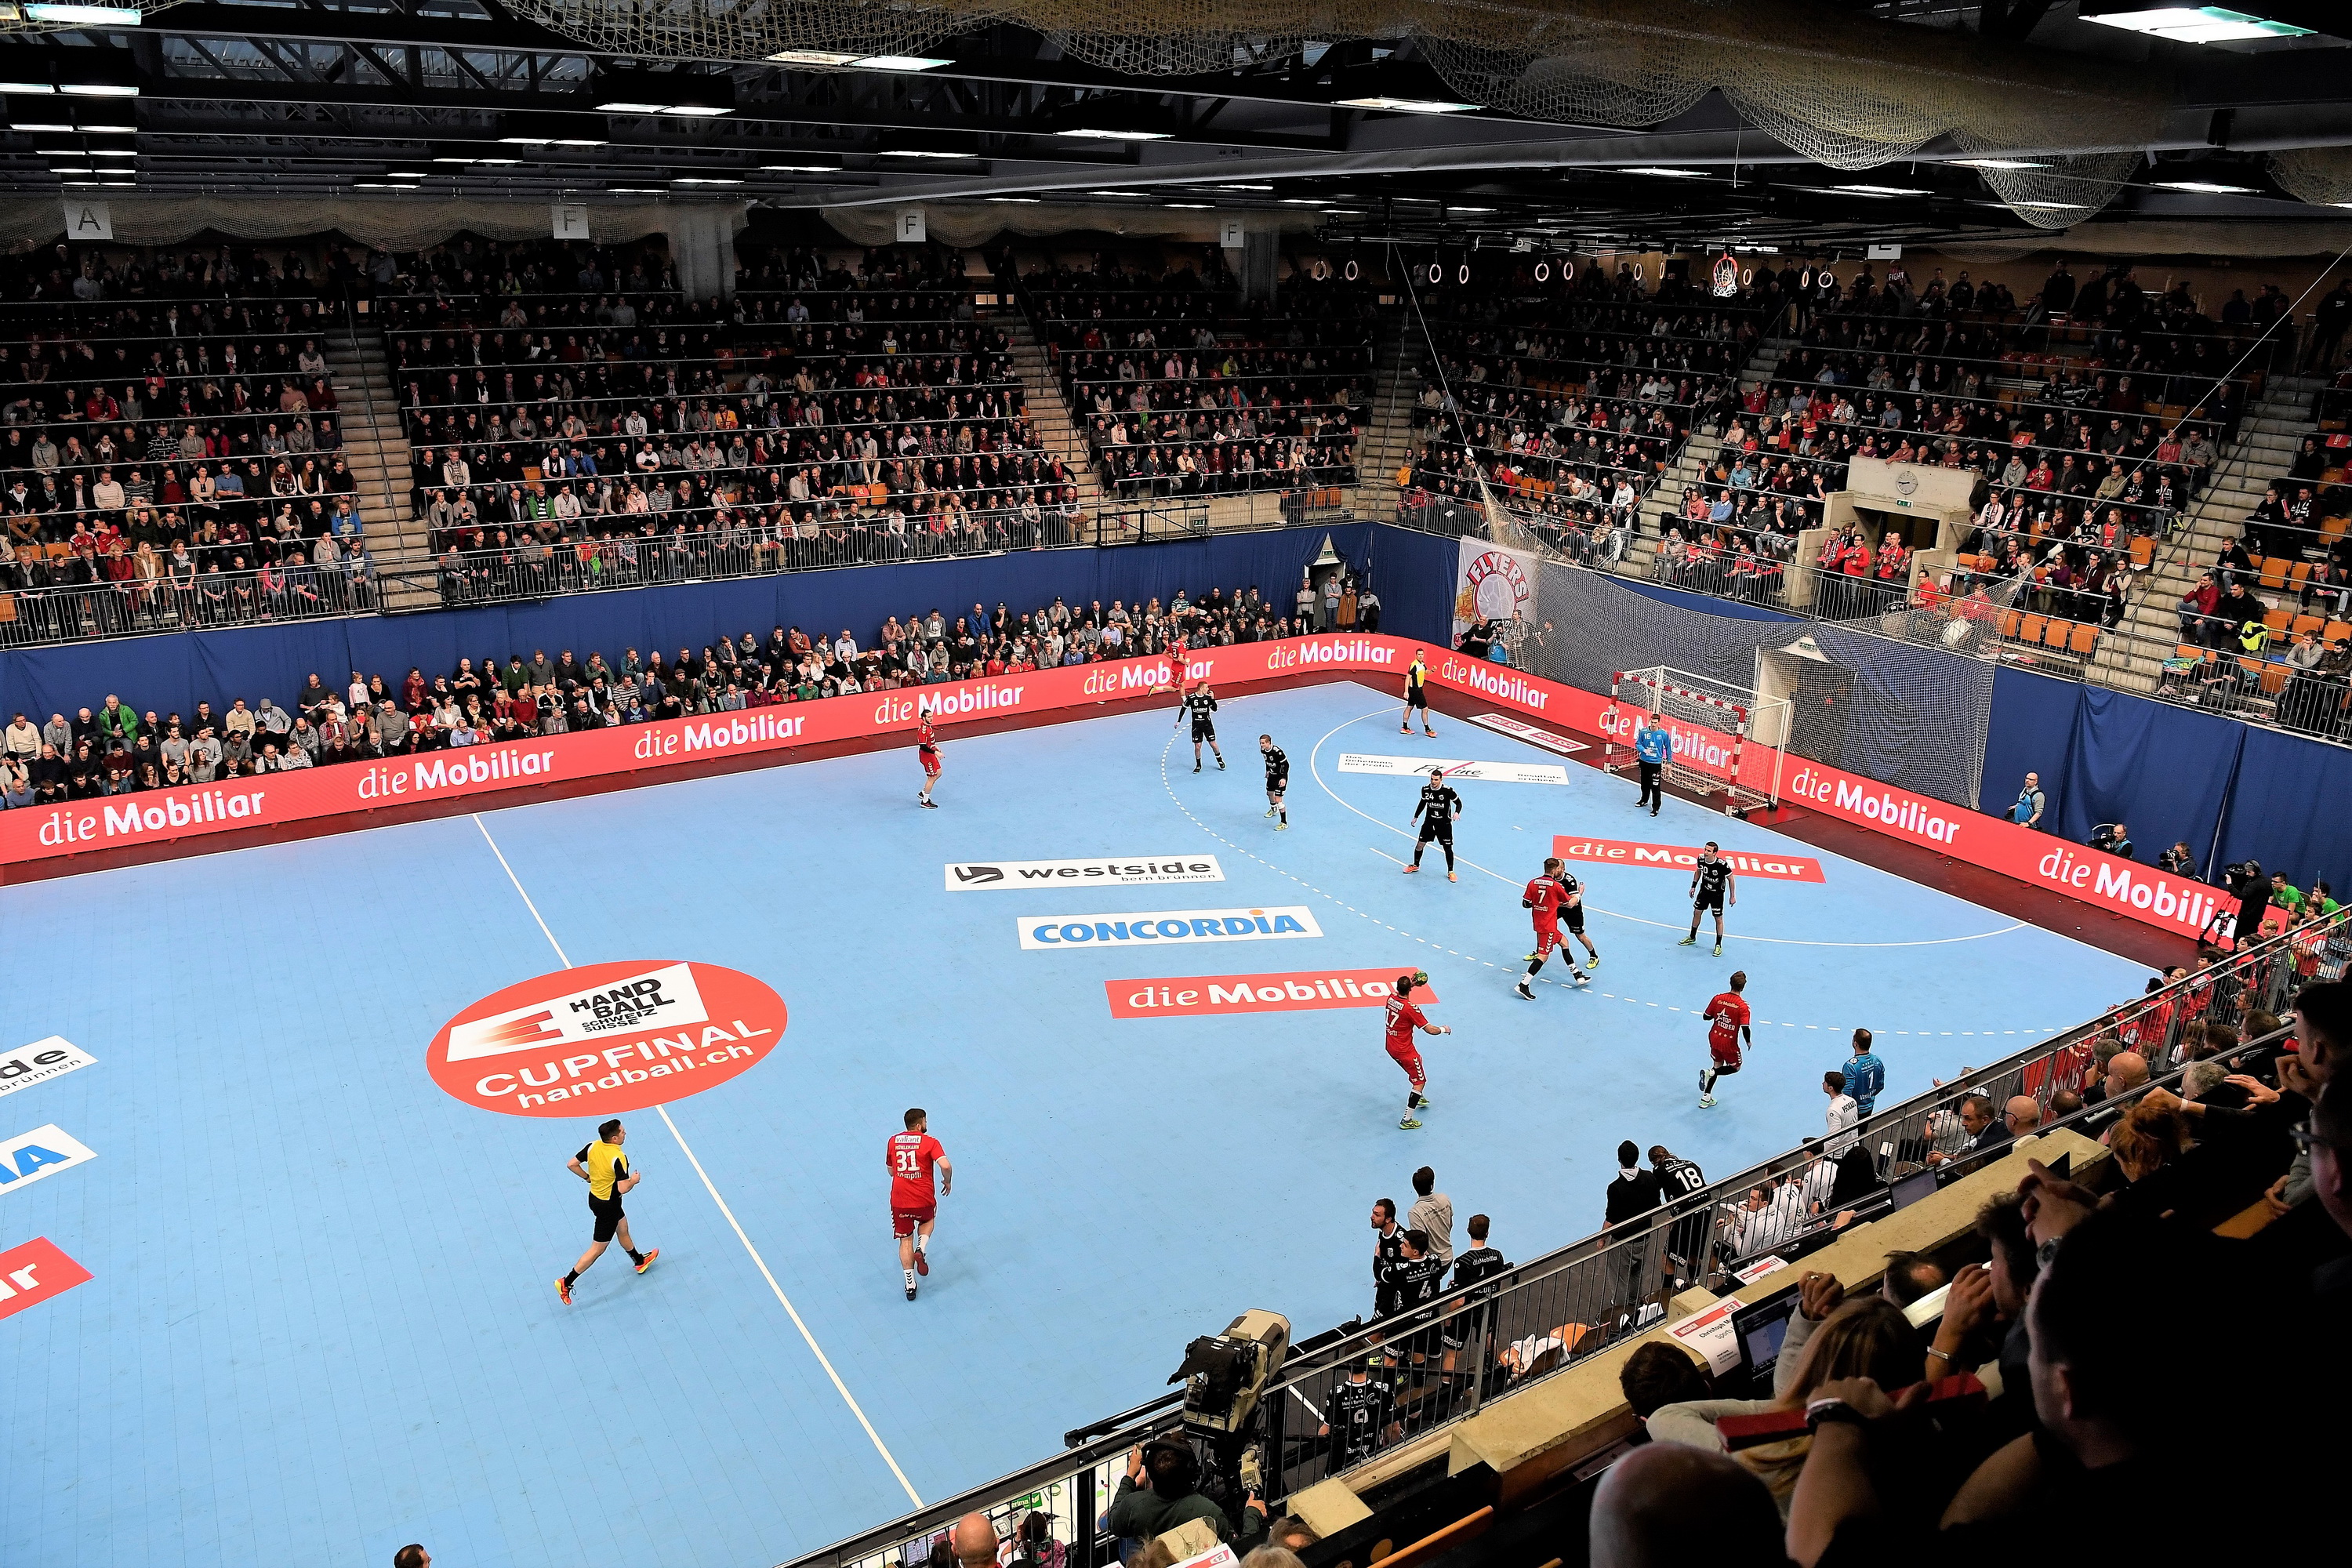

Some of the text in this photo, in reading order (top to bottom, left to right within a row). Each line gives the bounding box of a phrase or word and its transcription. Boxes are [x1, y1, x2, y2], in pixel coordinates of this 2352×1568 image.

[78, 207, 101, 231] A
[563, 209, 577, 231] F
[905, 215, 917, 235] F
[1228, 224, 1237, 241] F
[1470, 552, 1528, 598] FLYERS
[1268, 640, 1396, 670] die Mobiliar
[1083, 658, 1214, 695] die Mobiar
[1442, 656, 1549, 710] die Mobiliar
[874, 684, 1025, 725] die Mobiliar
[633, 713, 806, 760] die Mobiliar
[357, 747, 555, 801] die Mobiliar
[1425, 792, 1435, 800] 24
[1791, 768, 1961, 844] die Mobiliar
[38, 790, 266, 847] die Mobiliar
[1018, 862, 1212, 879] westside
[1569, 842, 1805, 877] die Moiliar
[1537, 889, 1547, 904] 7
[2038, 847, 2239, 939] die Mobilia
[568, 978, 662, 1013] HAND
[592, 992, 676, 1020] BALL
[1128, 986, 1200, 1009] die
[581, 1008, 658, 1028] SCHWEIZ
[584, 1018, 641, 1033] SUISSE
[1385, 1007, 1399, 1029] 17
[1717, 1020, 1736, 1031] SCORER
[474, 1019, 773, 1098] CUPFINAL
[517, 1044, 754, 1109] handball.ch
[1867, 1070, 1875, 1089] 1
[895, 1135, 920, 1144] valiant
[896, 1150, 920, 1172] 31
[1675, 1167, 1703, 1192] 18
[1418, 1280, 1432, 1299] 4
[1699, 1323, 1726, 1338] Christoph
[1715, 1329, 1733, 1340] Sports
